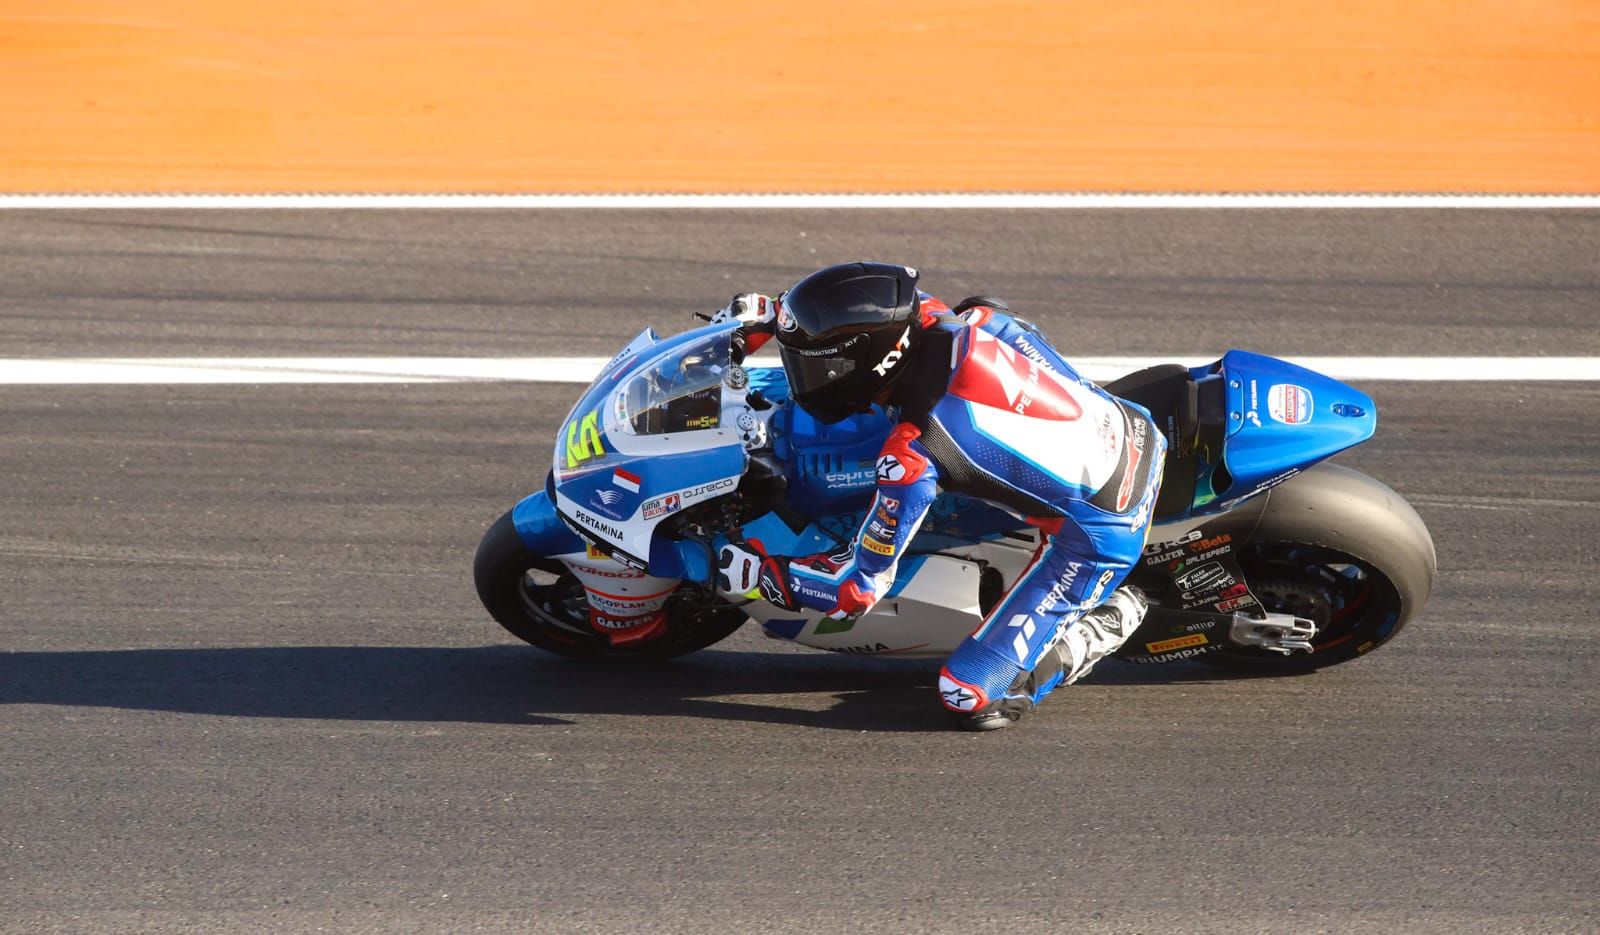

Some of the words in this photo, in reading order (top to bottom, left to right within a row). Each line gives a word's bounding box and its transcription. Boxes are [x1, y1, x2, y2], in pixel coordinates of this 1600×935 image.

[872, 325, 910, 376] KYT
[644, 504, 667, 517] racing
[575, 510, 624, 541] PERTAMINA
[1200, 534, 1232, 549] Beta
[1146, 549, 1186, 566] GALFER
[1206, 545, 1231, 560] SPEED
[591, 594, 646, 609] ECOPLAN
[802, 587, 837, 603] PERTAMINA
[1128, 646, 1207, 664] TRIUMPH
